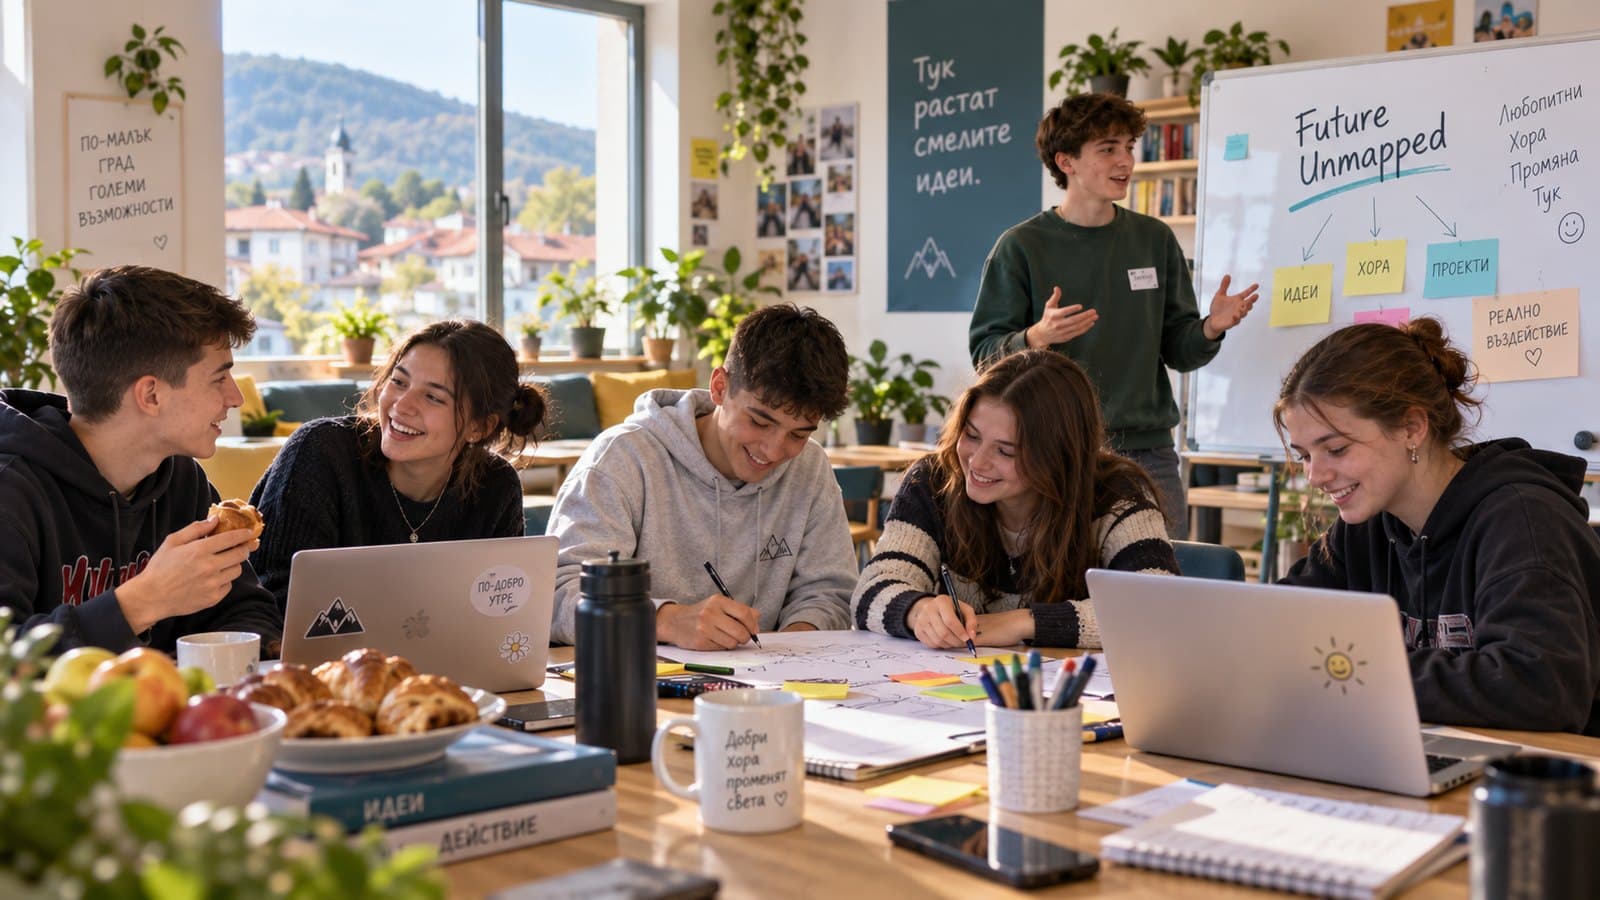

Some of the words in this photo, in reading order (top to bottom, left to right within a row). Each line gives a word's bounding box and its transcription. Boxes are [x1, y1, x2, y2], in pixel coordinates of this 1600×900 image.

[912, 55, 956, 91] Тук
[914, 87, 999, 130] растат
[1499, 84, 1583, 126] Любопитни
[80, 127, 153, 152] ПО-МАЛЪК
[914, 122, 1012, 158] смелите
[1295, 105, 1389, 147] Future
[1300, 111, 1447, 186] Unmapped
[1509, 127, 1547, 155] Хора
[98, 154, 136, 174] ГРАД
[1510, 149, 1579, 189] Промяна
[88, 178, 146, 201] ГОЛЕМИ
[916, 165, 981, 197] идеи.
[78, 197, 174, 228] ВЪЗМОЖНОСТИ
[1532, 185, 1562, 214] Тук
[1357, 258, 1391, 277] ХОРА
[1431, 257, 1490, 278] ПРОЕКТИ
[1282, 284, 1319, 304] ИДЕИ
[1488, 302, 1542, 326] РЕАЛНО
[1486, 321, 1569, 350] ВЪЗДЕЙСТВИЕ
[478, 576, 525, 593] ПО-ДОБРО
[488, 592, 514, 608] УТРЕ
[725, 727, 768, 752] Добри
[726, 754, 760, 773] хора
[726, 769, 787, 795] променят
[363, 791, 425, 823] ИДЕИ
[726, 792, 766, 811] света
[439, 814, 538, 856] ДЕЙСТВИЕ
